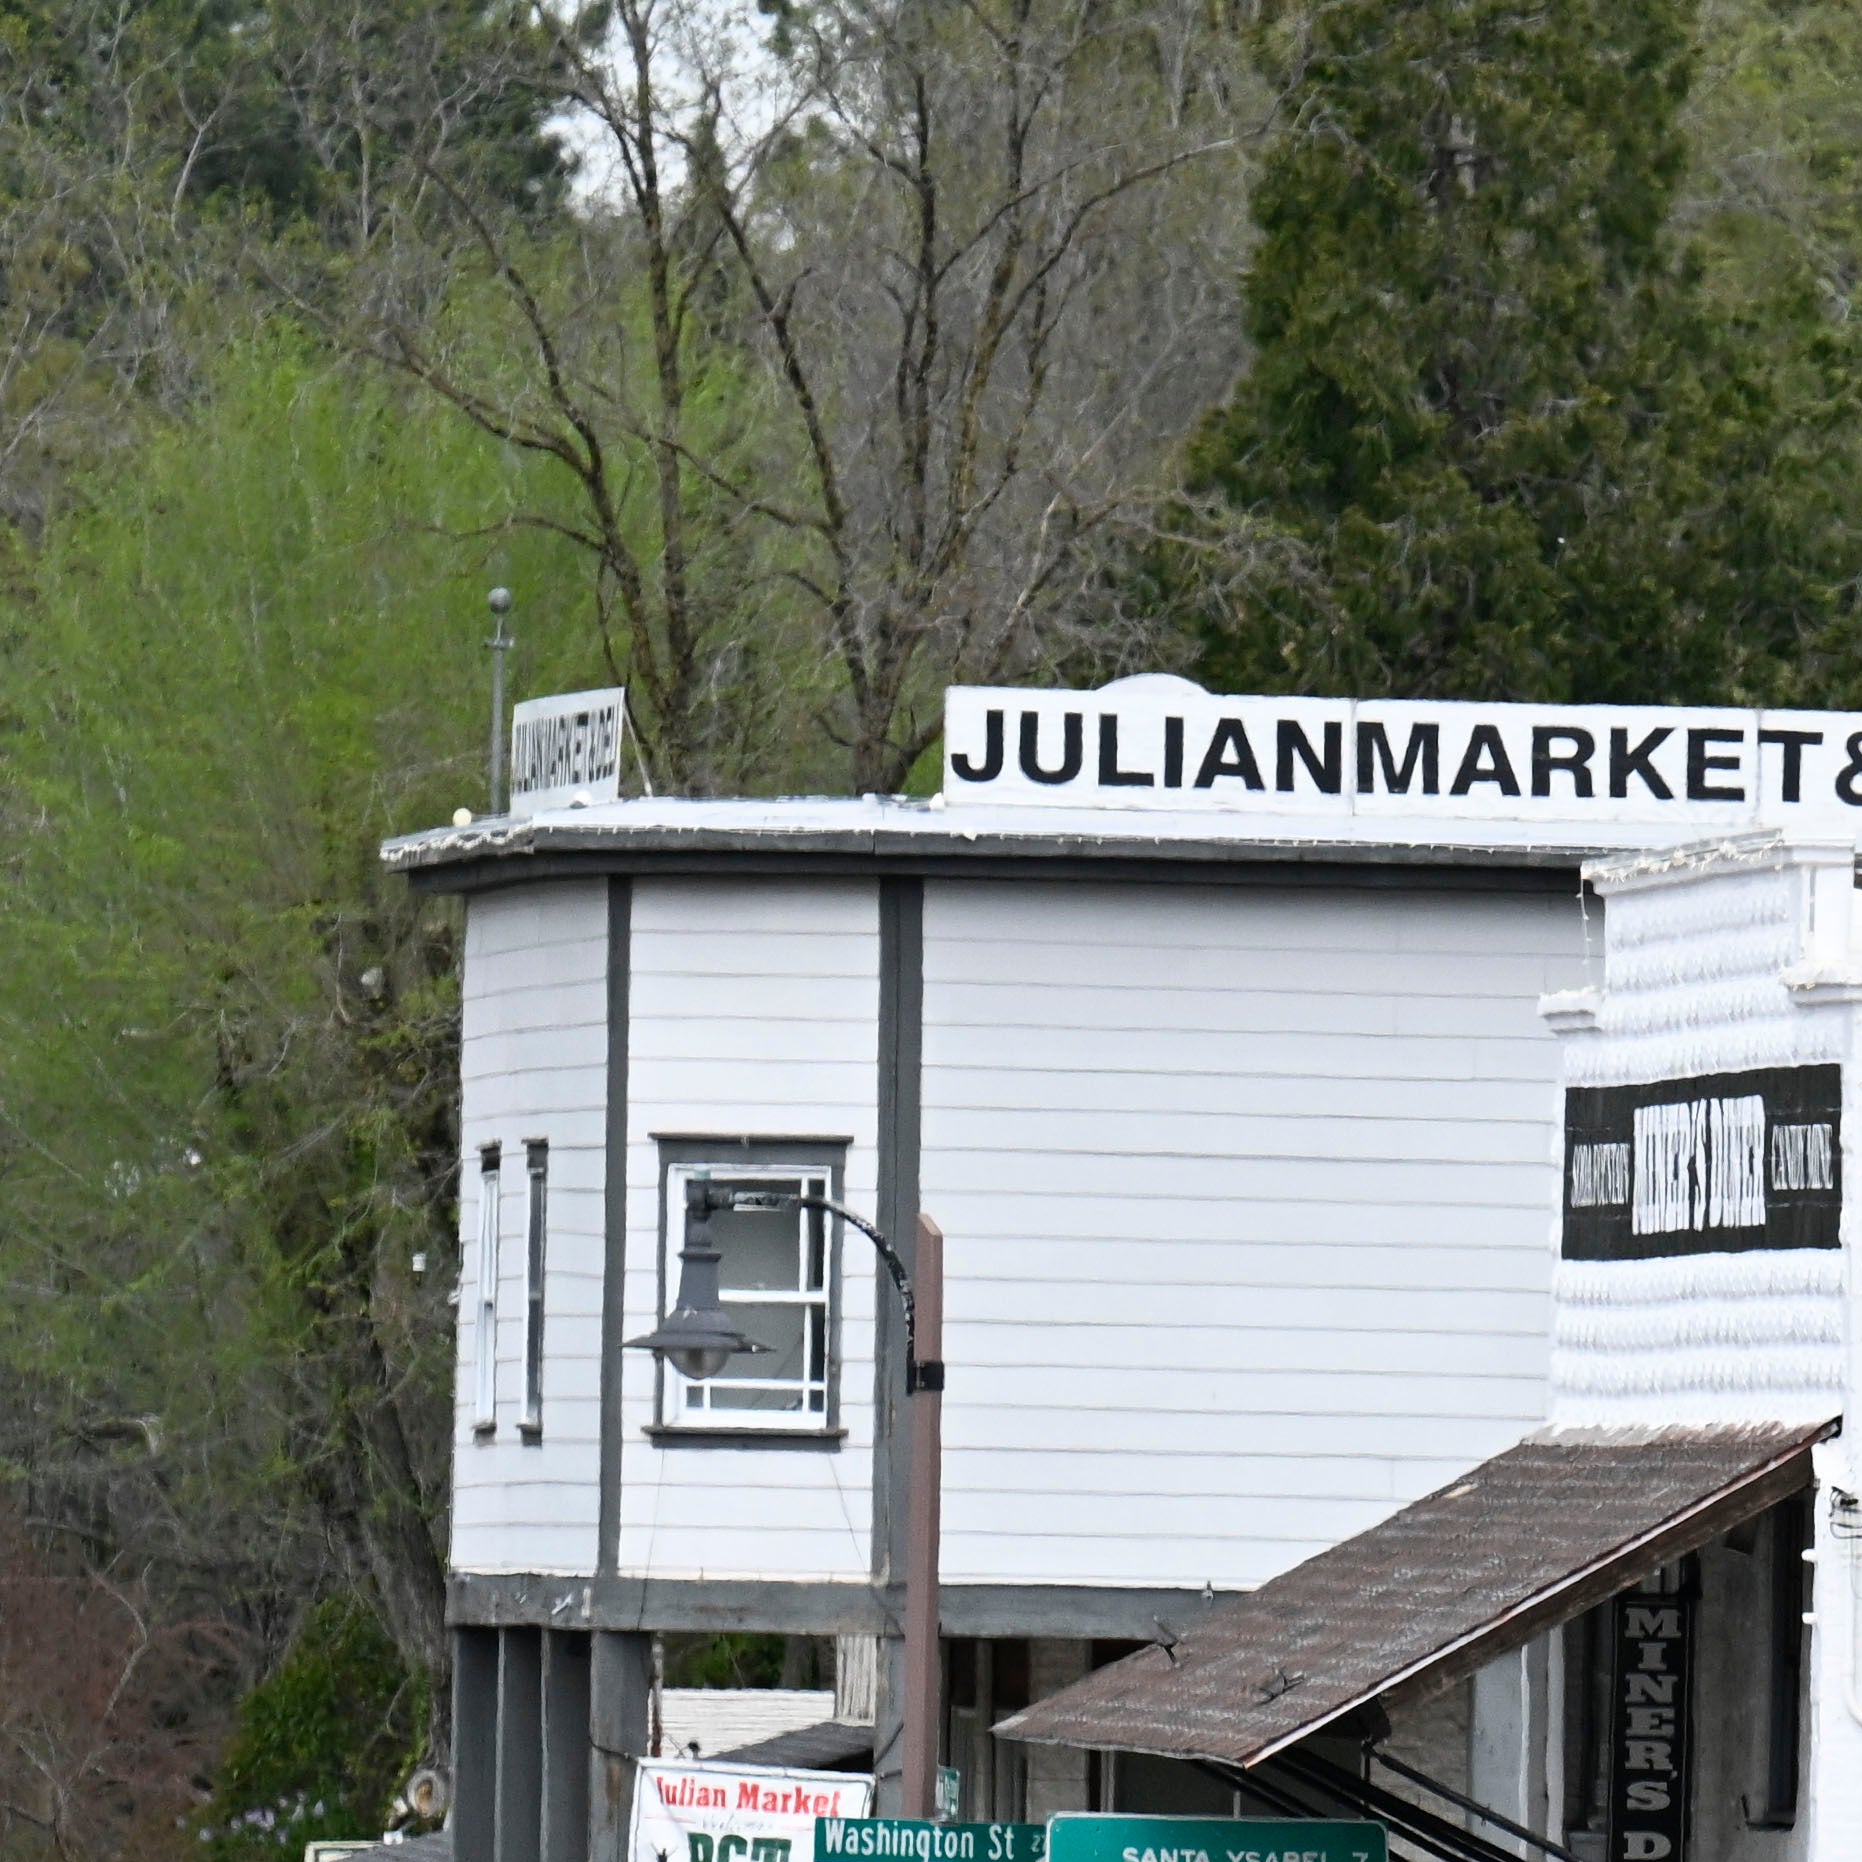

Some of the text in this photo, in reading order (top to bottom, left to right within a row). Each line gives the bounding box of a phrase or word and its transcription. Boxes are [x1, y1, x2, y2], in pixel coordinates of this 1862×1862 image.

[1632, 1094, 1767, 1235] MINER'S DINER
[1624, 1607, 1683, 1813] MINER'S
[656, 1775, 842, 1818] Julian Market
[987, 1824, 1016, 1861] St
